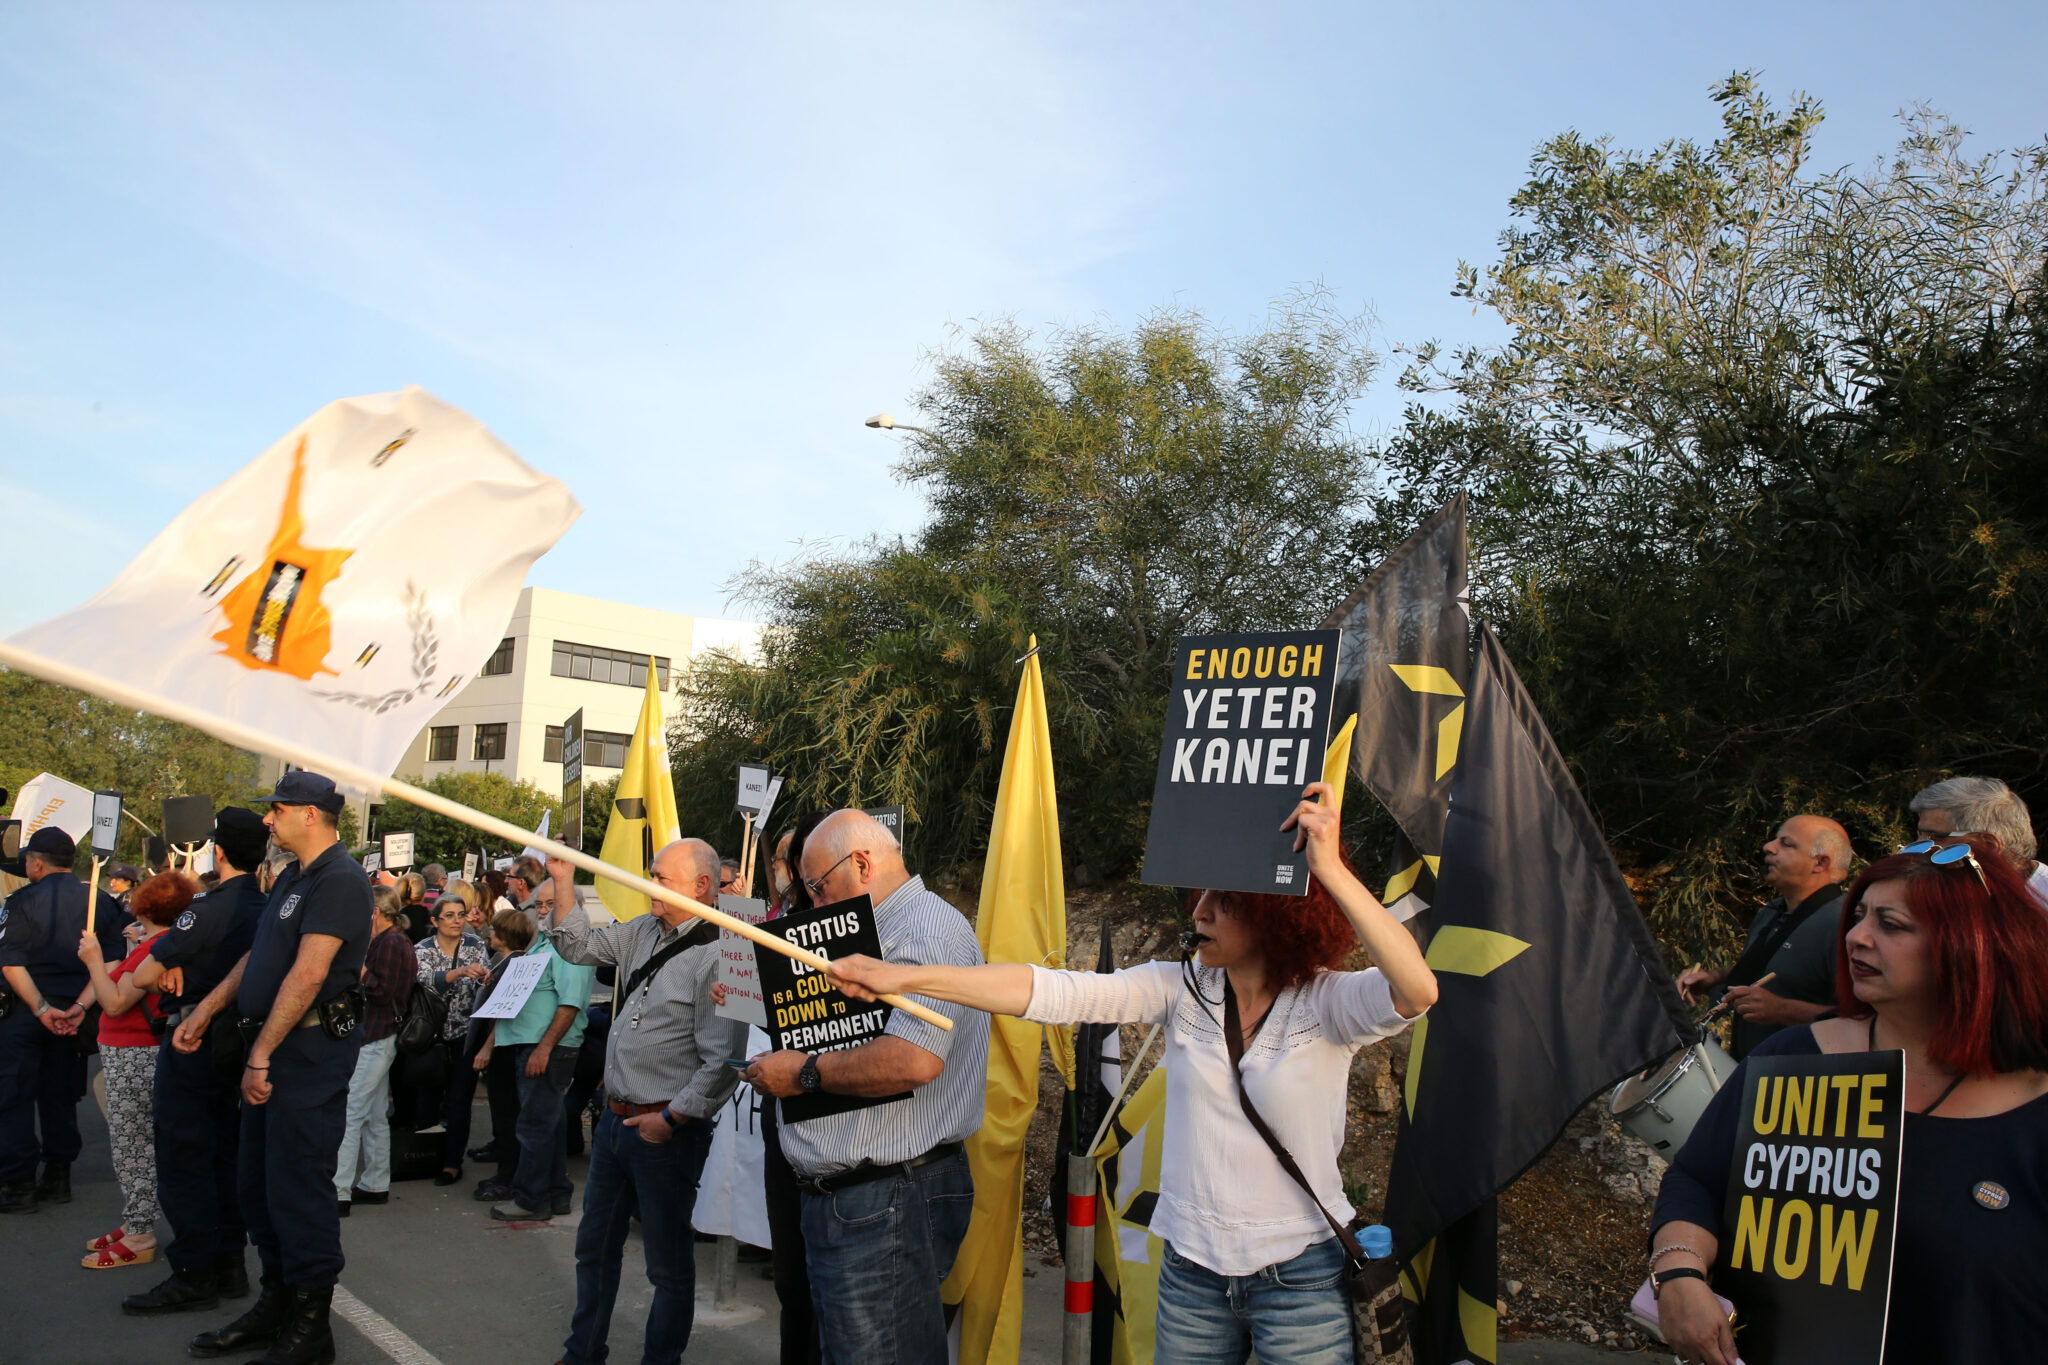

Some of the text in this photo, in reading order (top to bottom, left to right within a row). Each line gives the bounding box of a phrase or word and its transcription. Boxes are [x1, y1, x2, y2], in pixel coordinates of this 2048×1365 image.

[1187, 645, 1323, 679] ENOUGH
[1183, 686, 1316, 729] YETER
[1171, 738, 1310, 785] KANEI
[1275, 876, 1293, 884] NOW
[785, 911, 860, 947] STATUS
[720, 949, 754, 961] THERE IS
[729, 966, 734, 974] A
[737, 968, 752, 980] WAY
[773, 973, 836, 1005] IS A COU
[776, 998, 846, 1028] DOWN TO
[780, 1009, 885, 1050] PERMANENT
[1753, 1074, 1887, 1138] UNITE
[1744, 1142, 1881, 1200] CYPRUS
[1976, 1192, 2000, 1206] NOW
[1980, 1187, 2003, 1200] CYPRUS
[1982, 1183, 2005, 1196] UNITE
[1731, 1195, 1879, 1291] NOW
